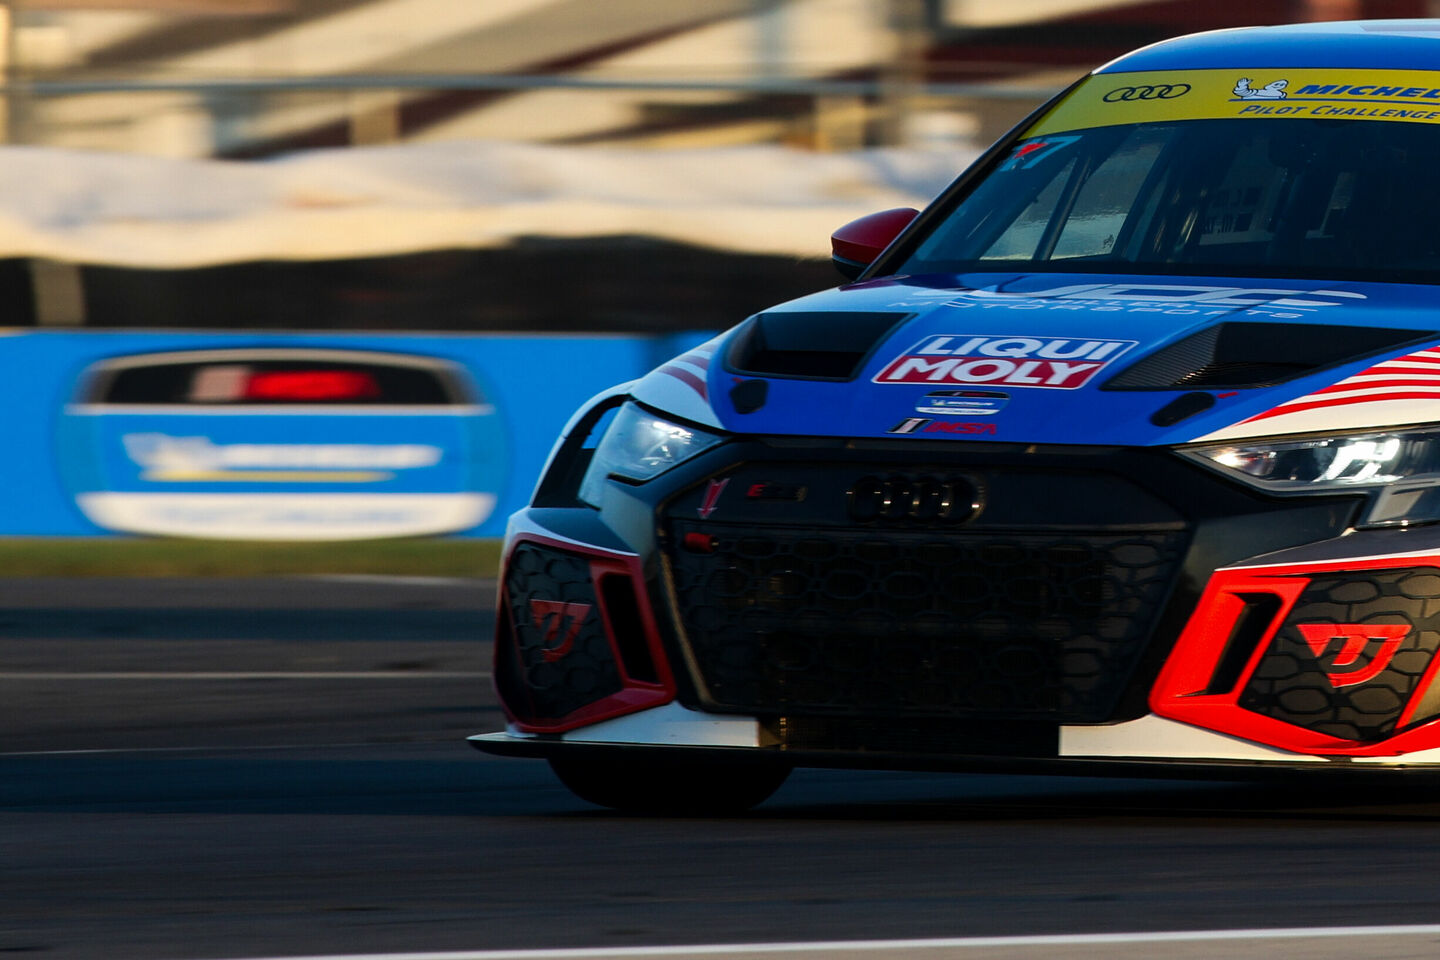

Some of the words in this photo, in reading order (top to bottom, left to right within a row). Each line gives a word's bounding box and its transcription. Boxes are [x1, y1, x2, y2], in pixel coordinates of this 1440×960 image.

[1238, 104, 1308, 116] PILOT
[917, 337, 1124, 359] LIQUI
[887, 358, 1102, 385] MOLY
